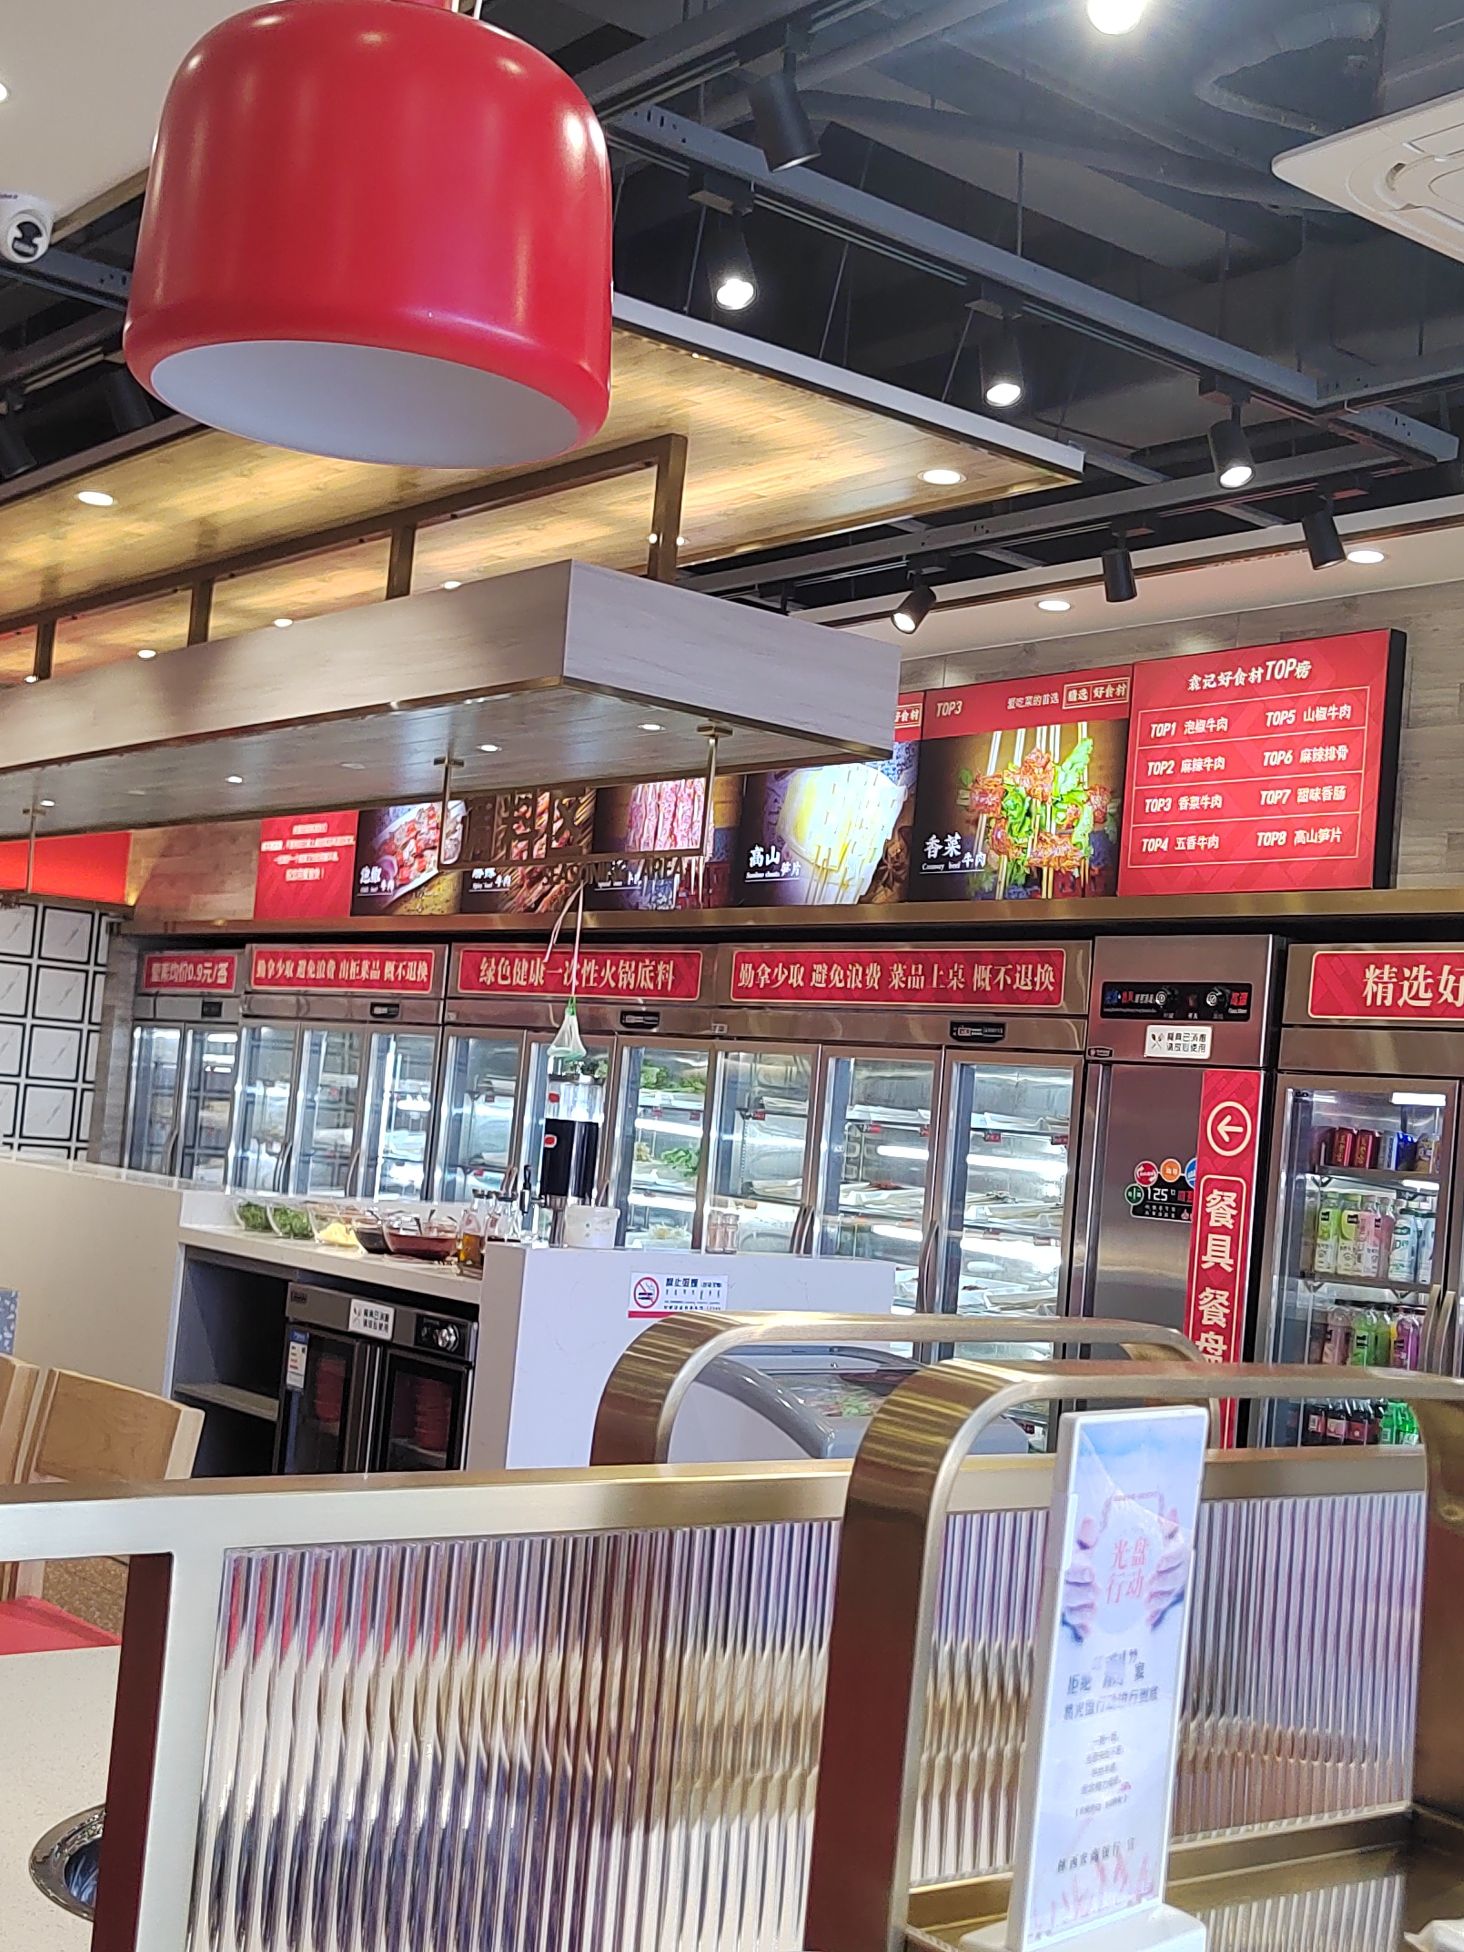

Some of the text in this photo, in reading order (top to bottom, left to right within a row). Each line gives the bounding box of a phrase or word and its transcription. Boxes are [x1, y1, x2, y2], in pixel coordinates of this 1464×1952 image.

[936, 700, 963, 718] TOP3
[1265, 709, 1296, 727] TOP5
[1150, 722, 1177, 738] TOP1
[1147, 760, 1175, 776] TOP2
[1263, 750, 1293, 767] TOP6
[1145, 797, 1172, 813] TOP3
[1260, 789, 1291, 805] TOP7
[1142, 833, 1219, 852] TOP4 五香牛肉
[1257, 831, 1287, 847] TOP8
[749, 844, 780, 868] 高山
[924, 832, 986, 868] 香菜 牛肉
[478, 956, 675, 992] 绿色健康一次性火锅底料
[738, 963, 1056, 993] 勤拿少取 避免浪费 菜品上桌 概不退换
[1362, 964, 1464, 1008] 精选好
[1200, 1188, 1239, 1273] 餐具
[1112, 1537, 1147, 1569] 光盘
[1106, 1568, 1145, 1604] 行动
